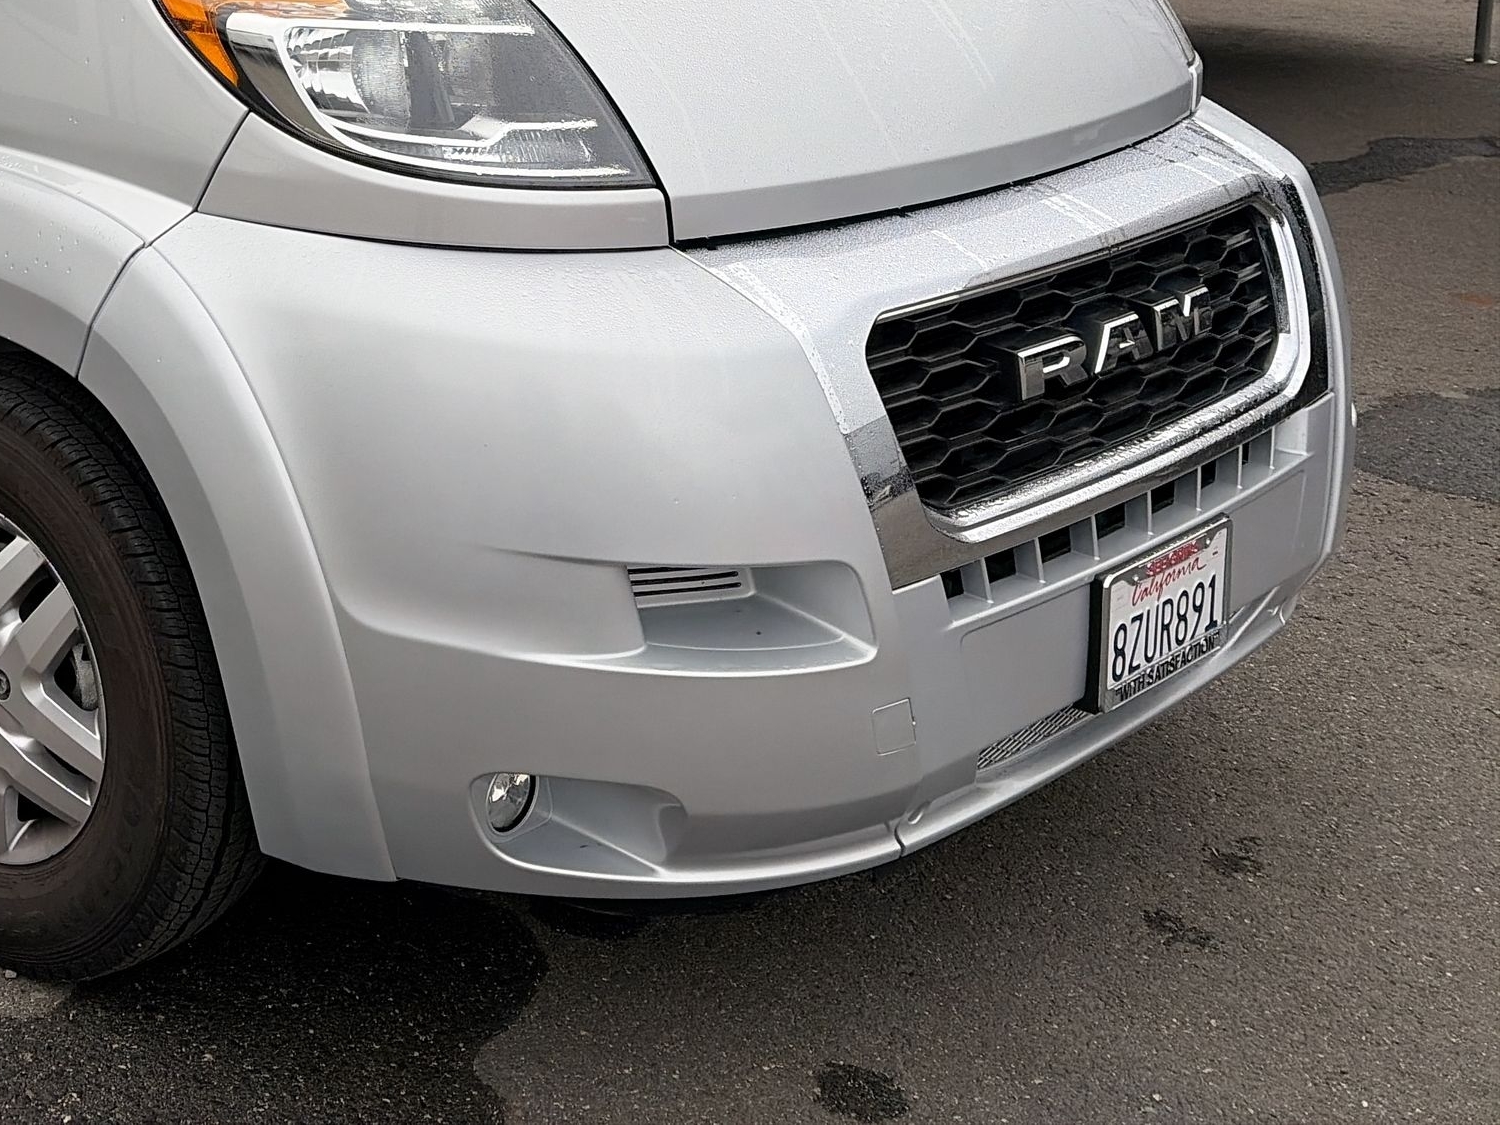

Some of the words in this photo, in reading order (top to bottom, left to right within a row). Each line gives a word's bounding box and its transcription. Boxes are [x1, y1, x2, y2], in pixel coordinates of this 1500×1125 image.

[1017, 286, 1213, 401] RAM
[1112, 573, 1218, 683] 8ZUR891
[1132, 557, 1207, 607] California
